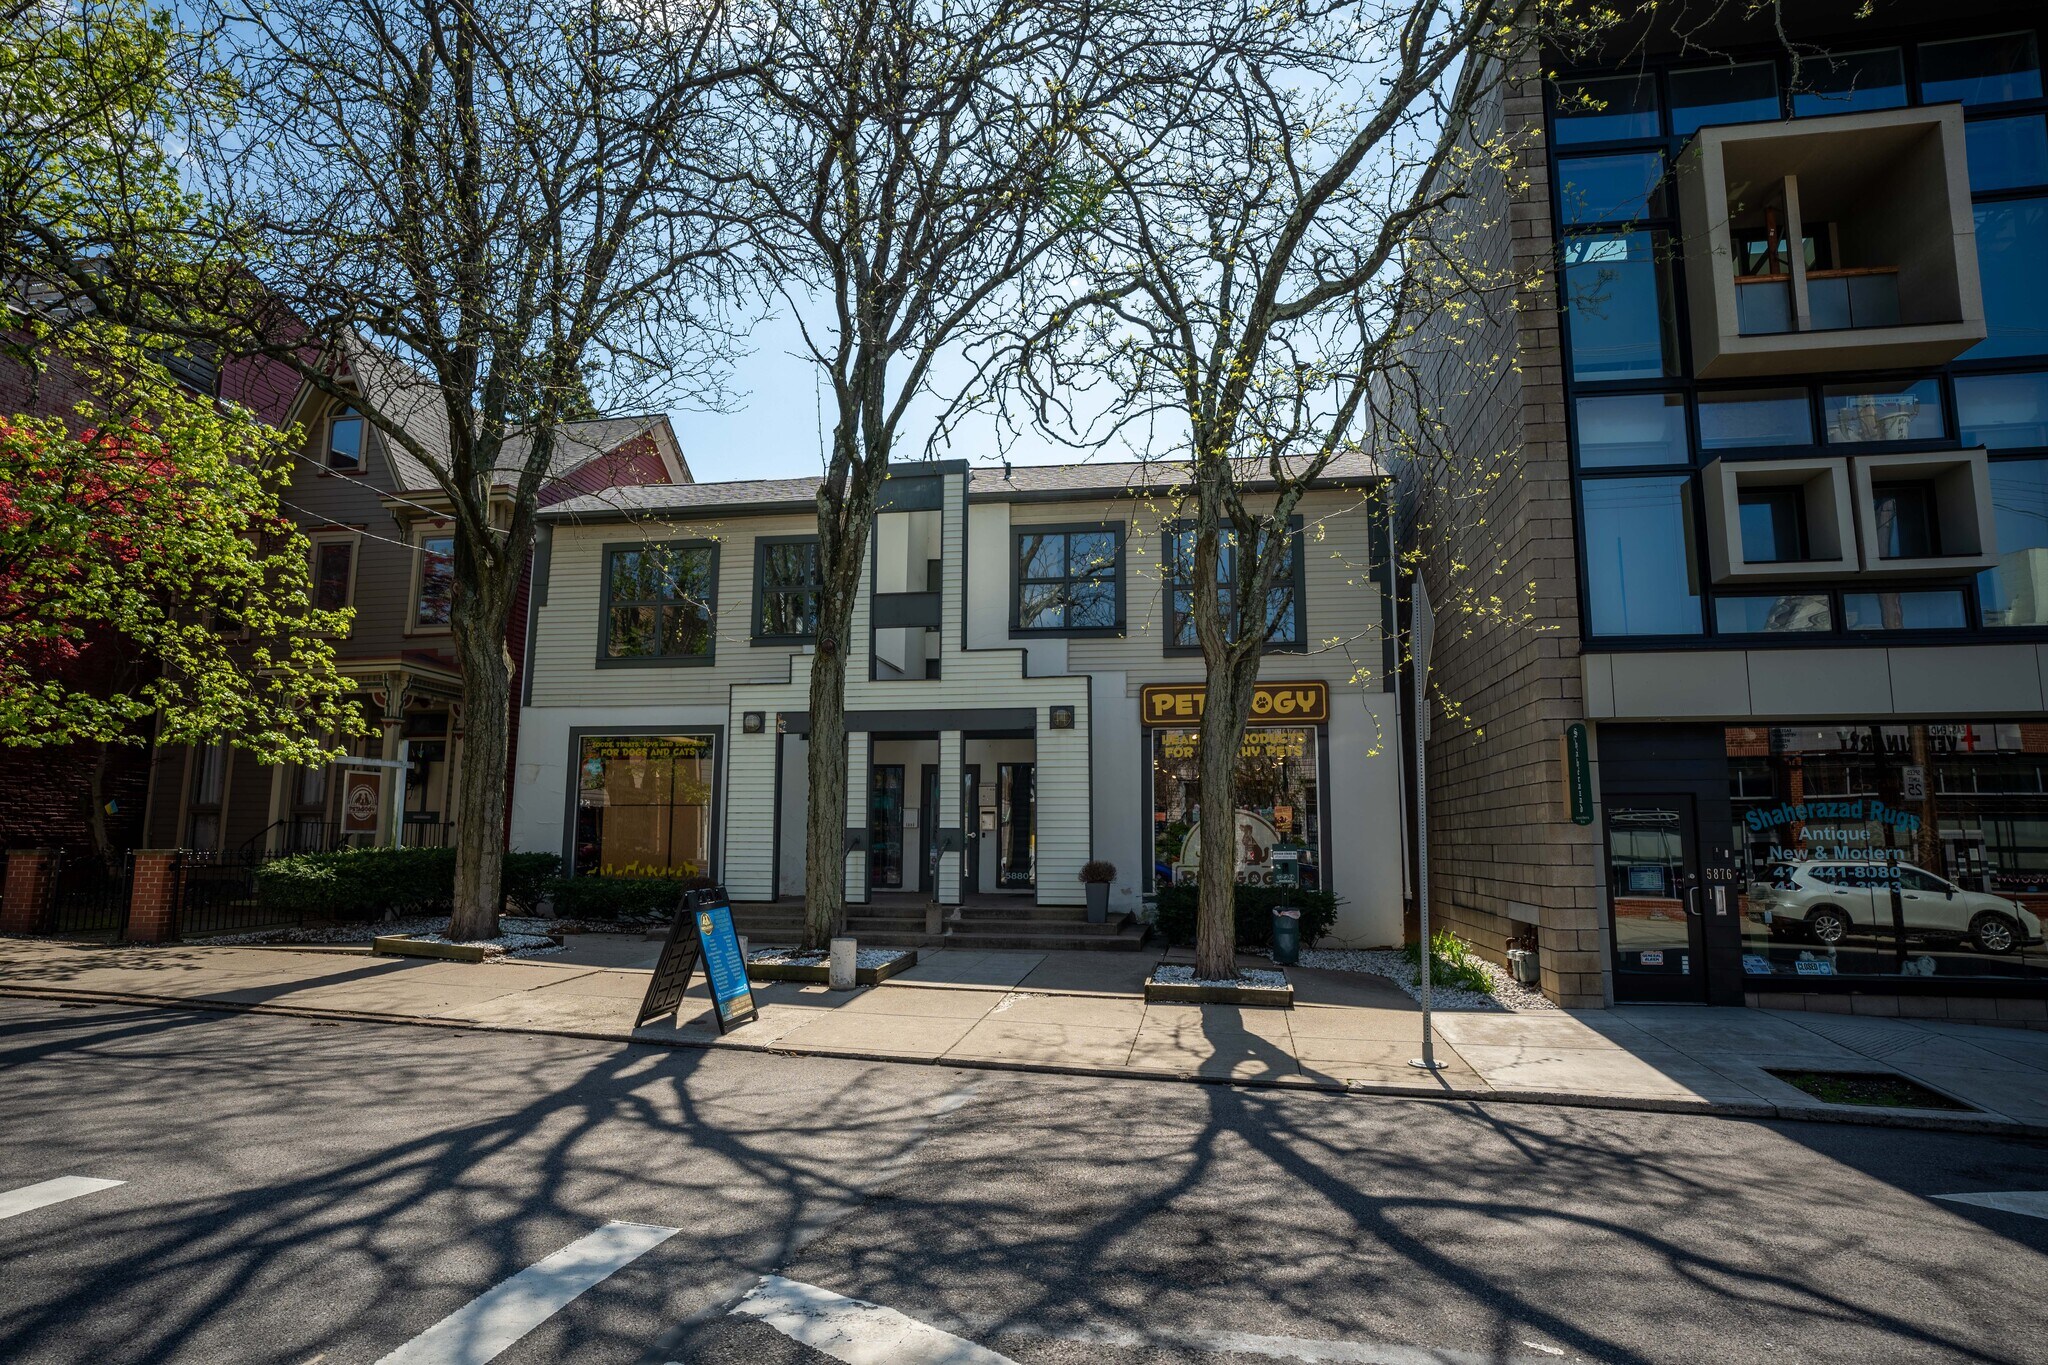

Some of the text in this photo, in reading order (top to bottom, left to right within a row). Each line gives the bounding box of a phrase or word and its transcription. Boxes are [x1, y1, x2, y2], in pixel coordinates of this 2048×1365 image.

[601, 747, 696, 756] FOR DOGS AND CATS
[1165, 747, 1194, 758] FOR
[1266, 745, 1303, 757] PETS
[1745, 799, 1921, 832] Shaherazad Rugs
[1798, 826, 1871, 843] Antique
[1769, 845, 1905, 860] New & Modern
[1005, 872, 1029, 880] 5880
[1706, 868, 1732, 880] 5876
[1773, 866, 1901, 878] 41-441-8080
[1708, 888, 1713, 900] 1
